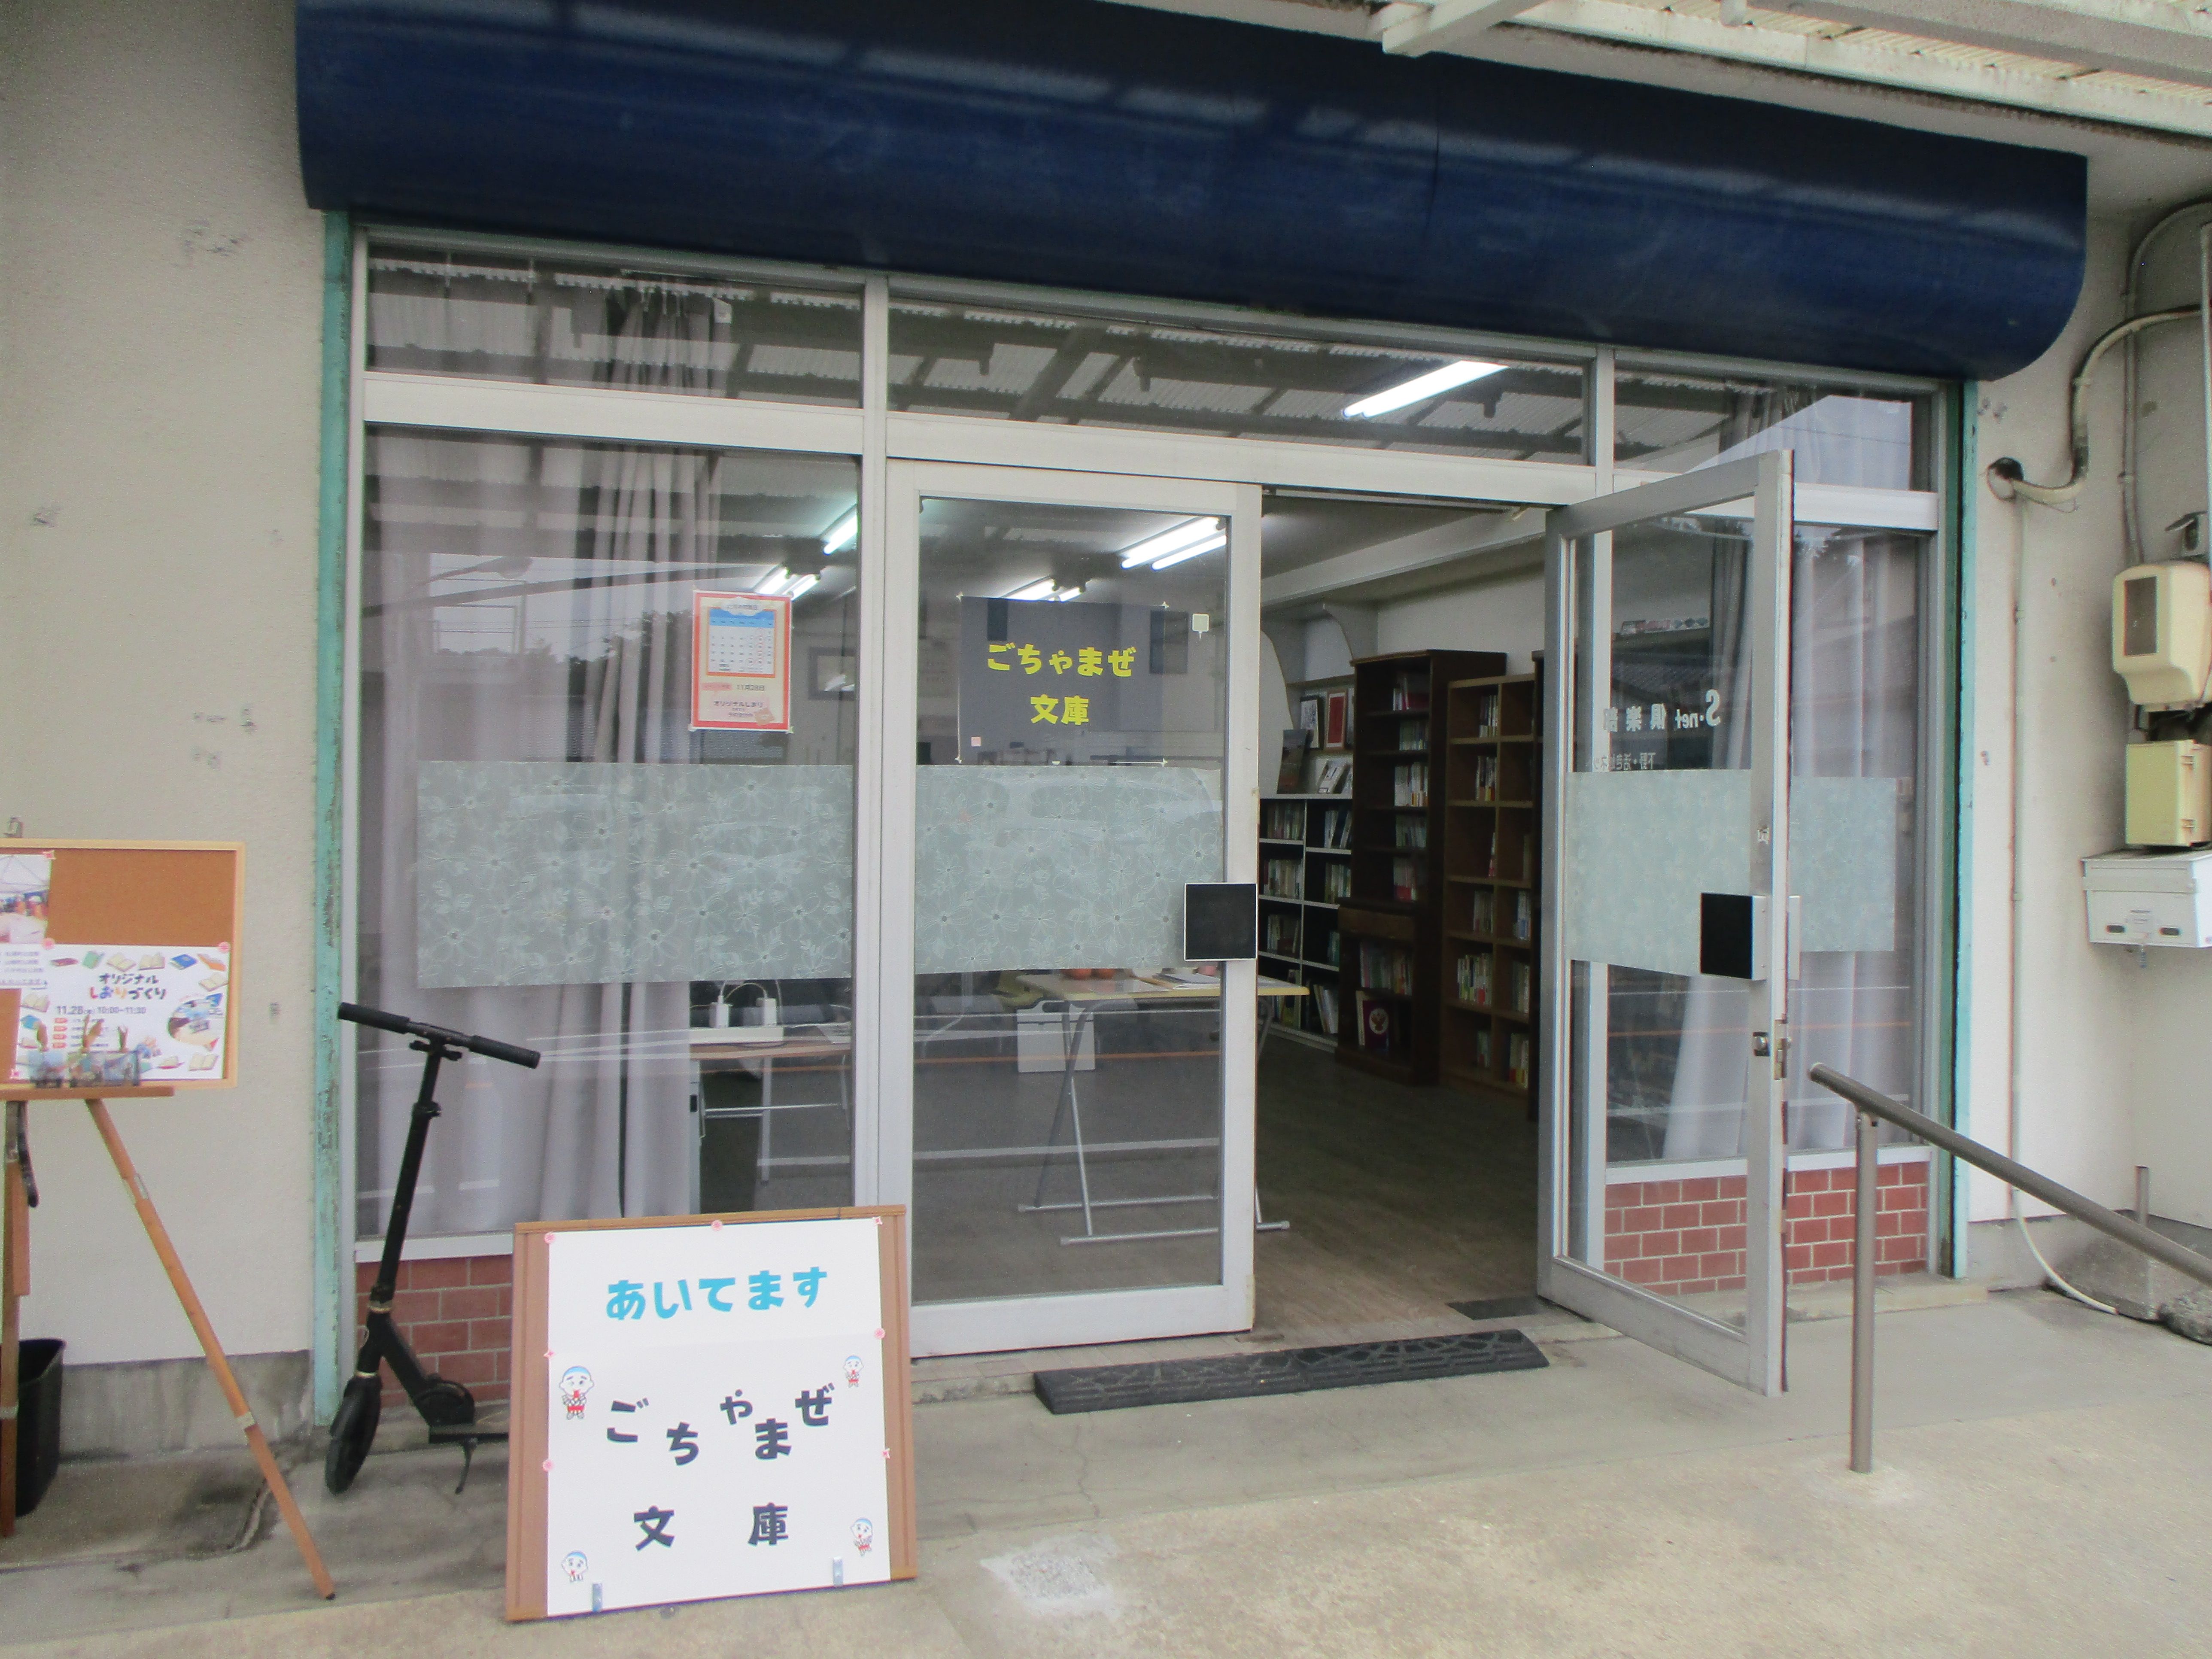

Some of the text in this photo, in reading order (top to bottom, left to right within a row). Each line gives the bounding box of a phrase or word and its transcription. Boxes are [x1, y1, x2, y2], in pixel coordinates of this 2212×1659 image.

[988, 641, 1137, 677] ごちゃまぜ
[1030, 694, 1089, 726] 文庫
[89, 985, 167, 1000] しおりづくり
[98, 973, 160, 984] オリジナル
[606, 1266, 828, 1321] あいてます
[606, 1382, 835, 1466] ごちゃまぜ
[633, 1502, 789, 1551] 文庫
